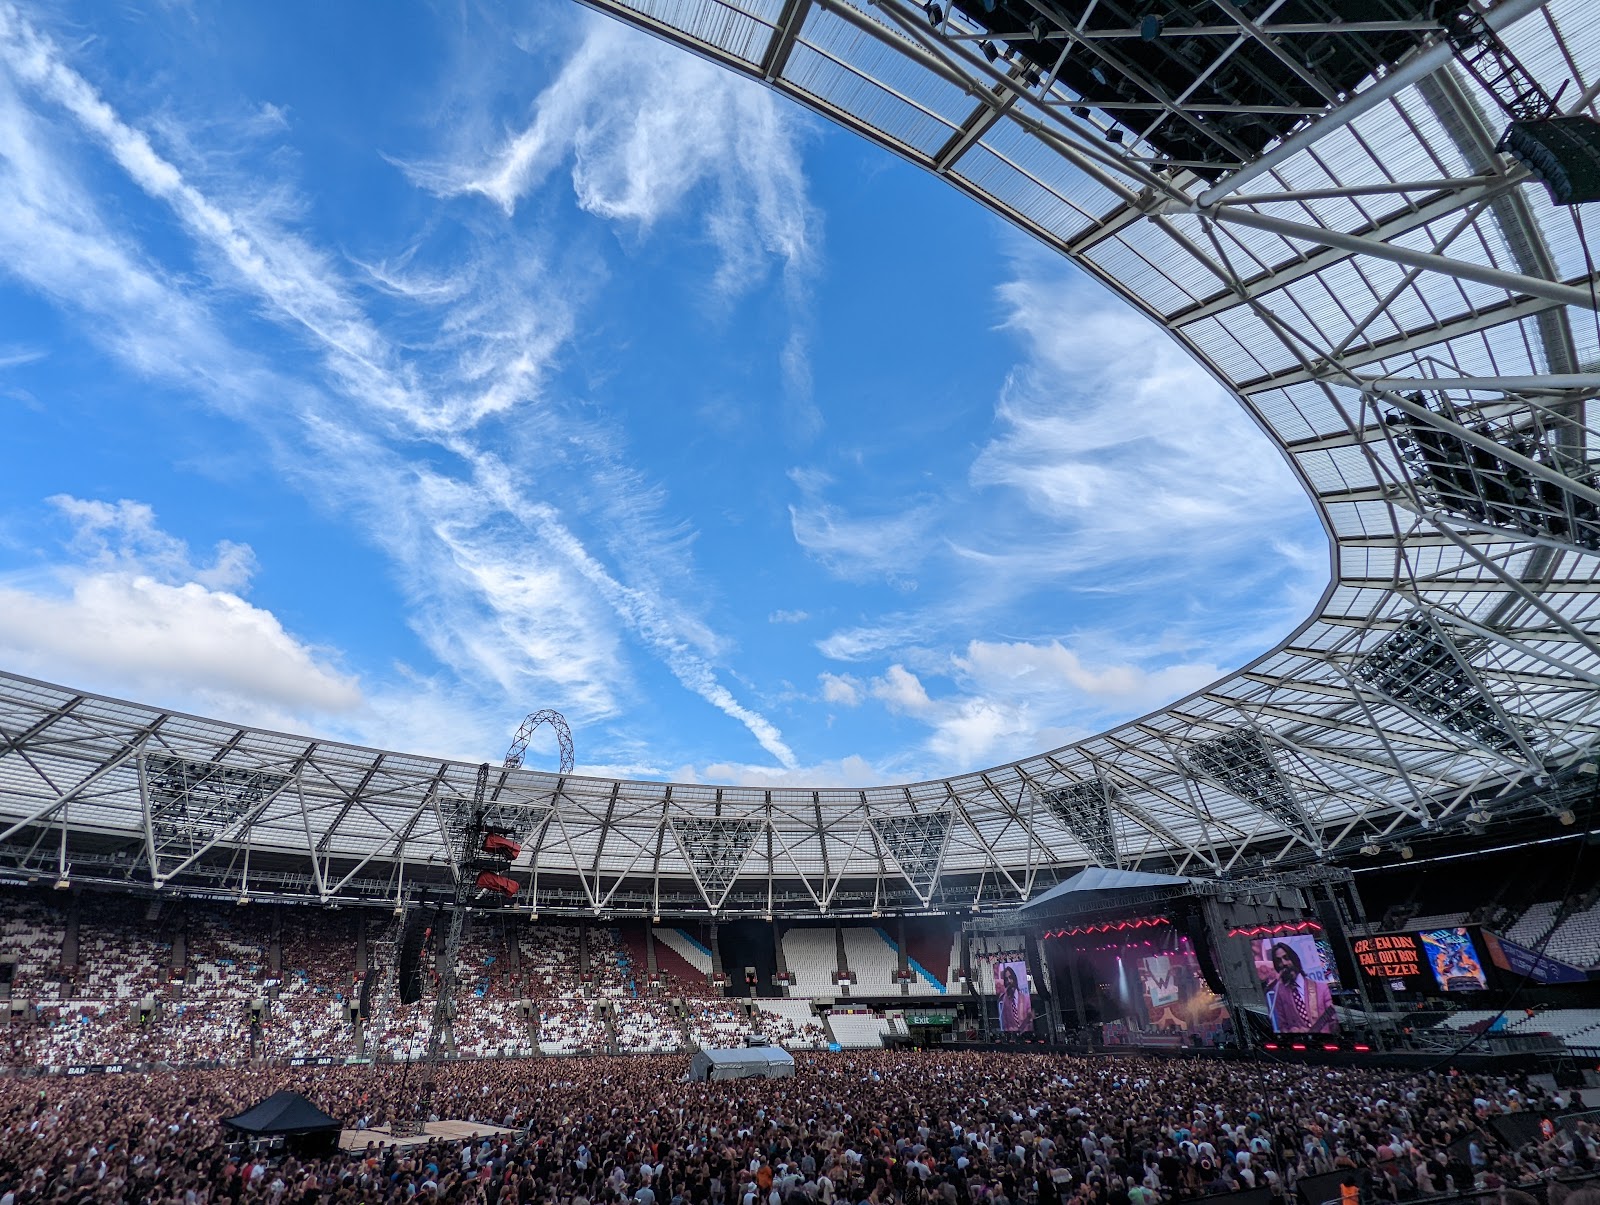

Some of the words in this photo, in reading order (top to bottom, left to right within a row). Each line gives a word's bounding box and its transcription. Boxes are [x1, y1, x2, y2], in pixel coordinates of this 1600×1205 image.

[1390, 937, 1416, 948] DAY
[1378, 950, 1398, 963] OUT
[1397, 950, 1418, 962] BOY
[1365, 964, 1420, 976] WEEZER
[914, 1016, 930, 1024] Exit
